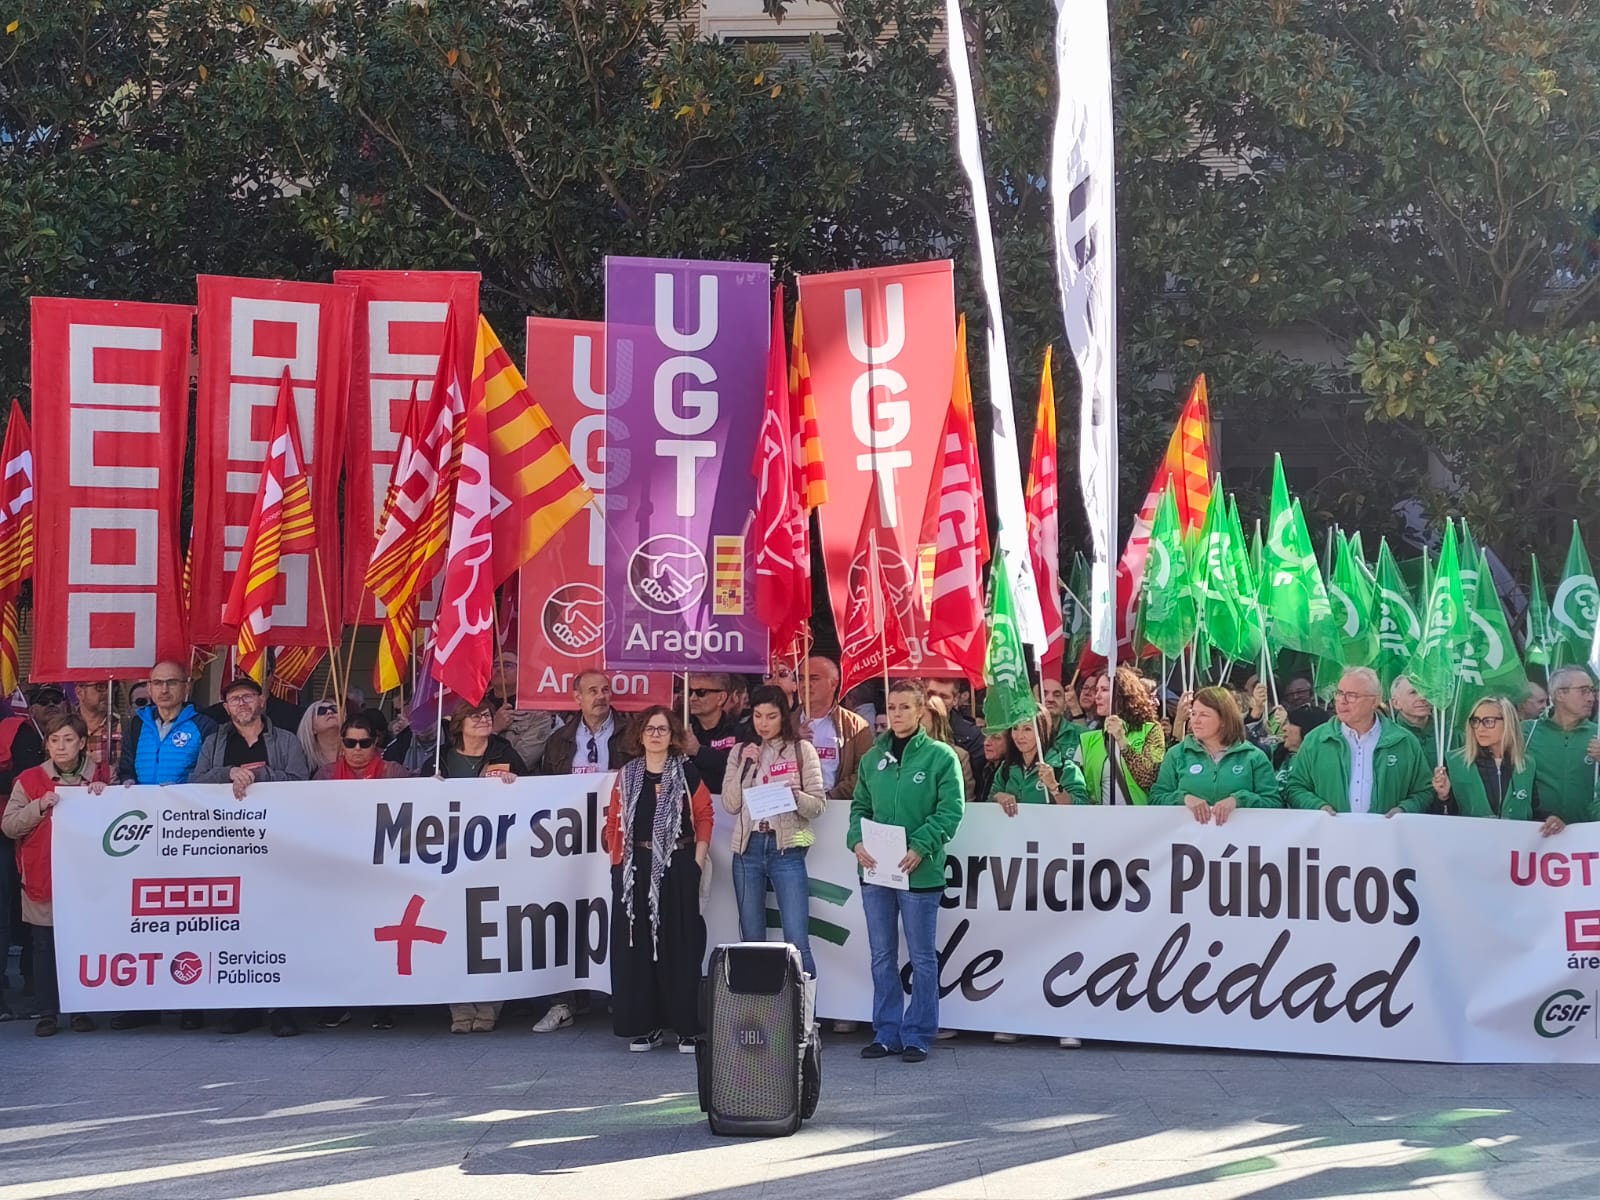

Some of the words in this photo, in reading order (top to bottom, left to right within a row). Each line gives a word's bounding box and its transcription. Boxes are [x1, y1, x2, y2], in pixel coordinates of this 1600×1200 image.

[653, 272, 720, 517] UGT
[844, 283, 913, 528] UGT
[67, 324, 162, 668] CCOO
[626, 623, 744, 661] Aragón
[537, 662, 649, 696] Arón
[771, 763, 787, 772] UGT
[162, 809, 210, 821] Central
[213, 809, 267, 821] Sindical
[162, 826, 255, 840] Independiente
[259, 828, 267, 840] y
[162, 844, 178, 856] de
[183, 843, 268, 856] Funcionarios
[373, 801, 517, 874] Mejor
[940, 841, 1151, 914] ervicios
[1171, 844, 1419, 926] Públicos
[1510, 850, 1599, 887] UGT
[139, 884, 234, 908] CCOO
[130, 918, 170, 933] área
[176, 917, 240, 935] pública
[465, 886, 609, 979] Emp
[79, 953, 164, 987] UGT
[218, 951, 286, 965] Servicios
[900, 918, 1004, 1001] de
[1043, 922, 1420, 1029] calidad
[1567, 953, 1600, 969] áre
[217, 969, 281, 984] Públicos
[740, 1030, 764, 1045] JBL
